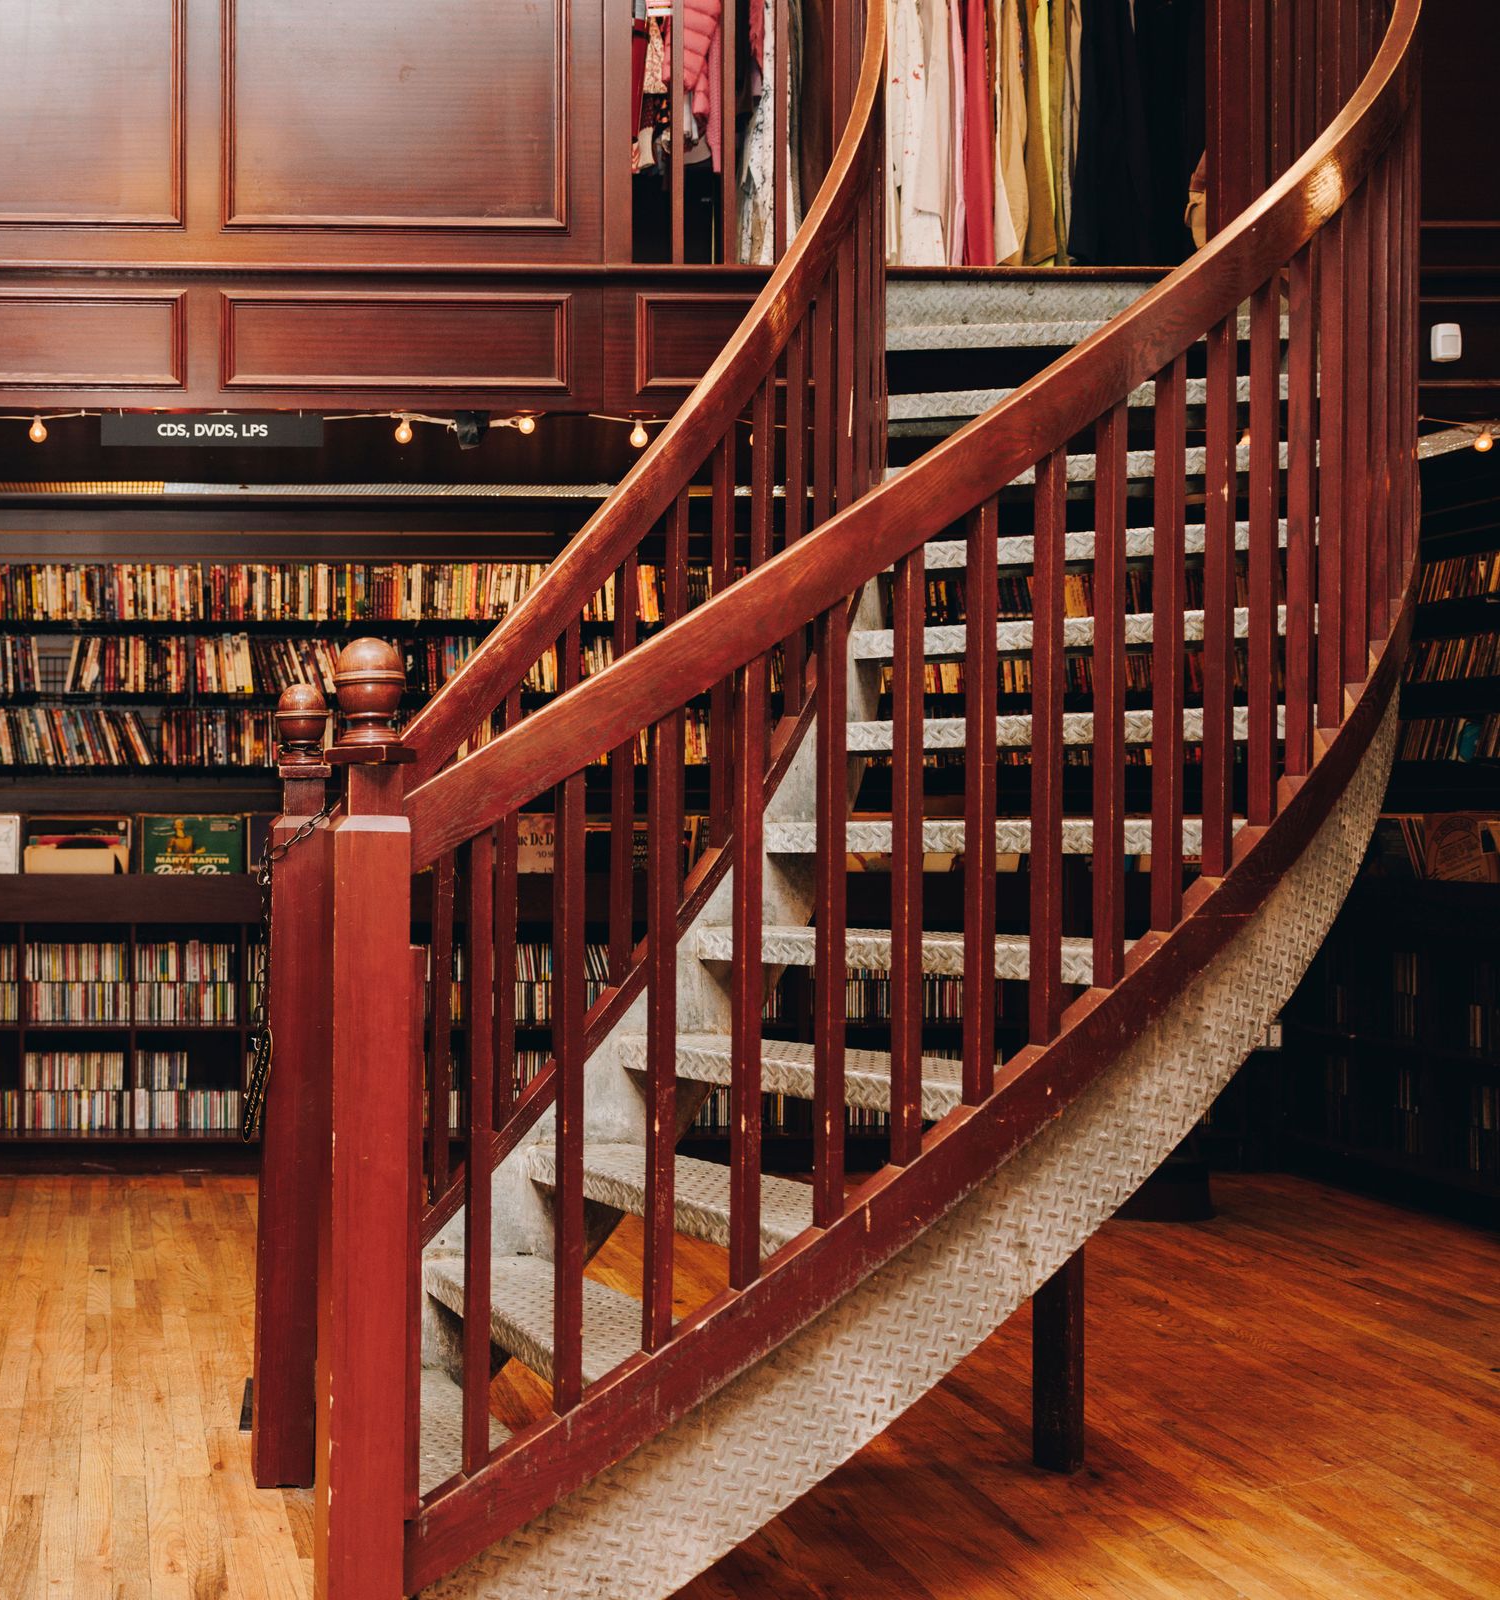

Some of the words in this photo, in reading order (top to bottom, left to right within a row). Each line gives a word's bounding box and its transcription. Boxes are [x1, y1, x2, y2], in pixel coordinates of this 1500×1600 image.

[157, 423, 190, 438] CDS,
[194, 423, 238, 438] DVDS,
[242, 424, 268, 437] LPS
[155, 856, 185, 865] MARY
[188, 856, 230, 865] MARTIN
